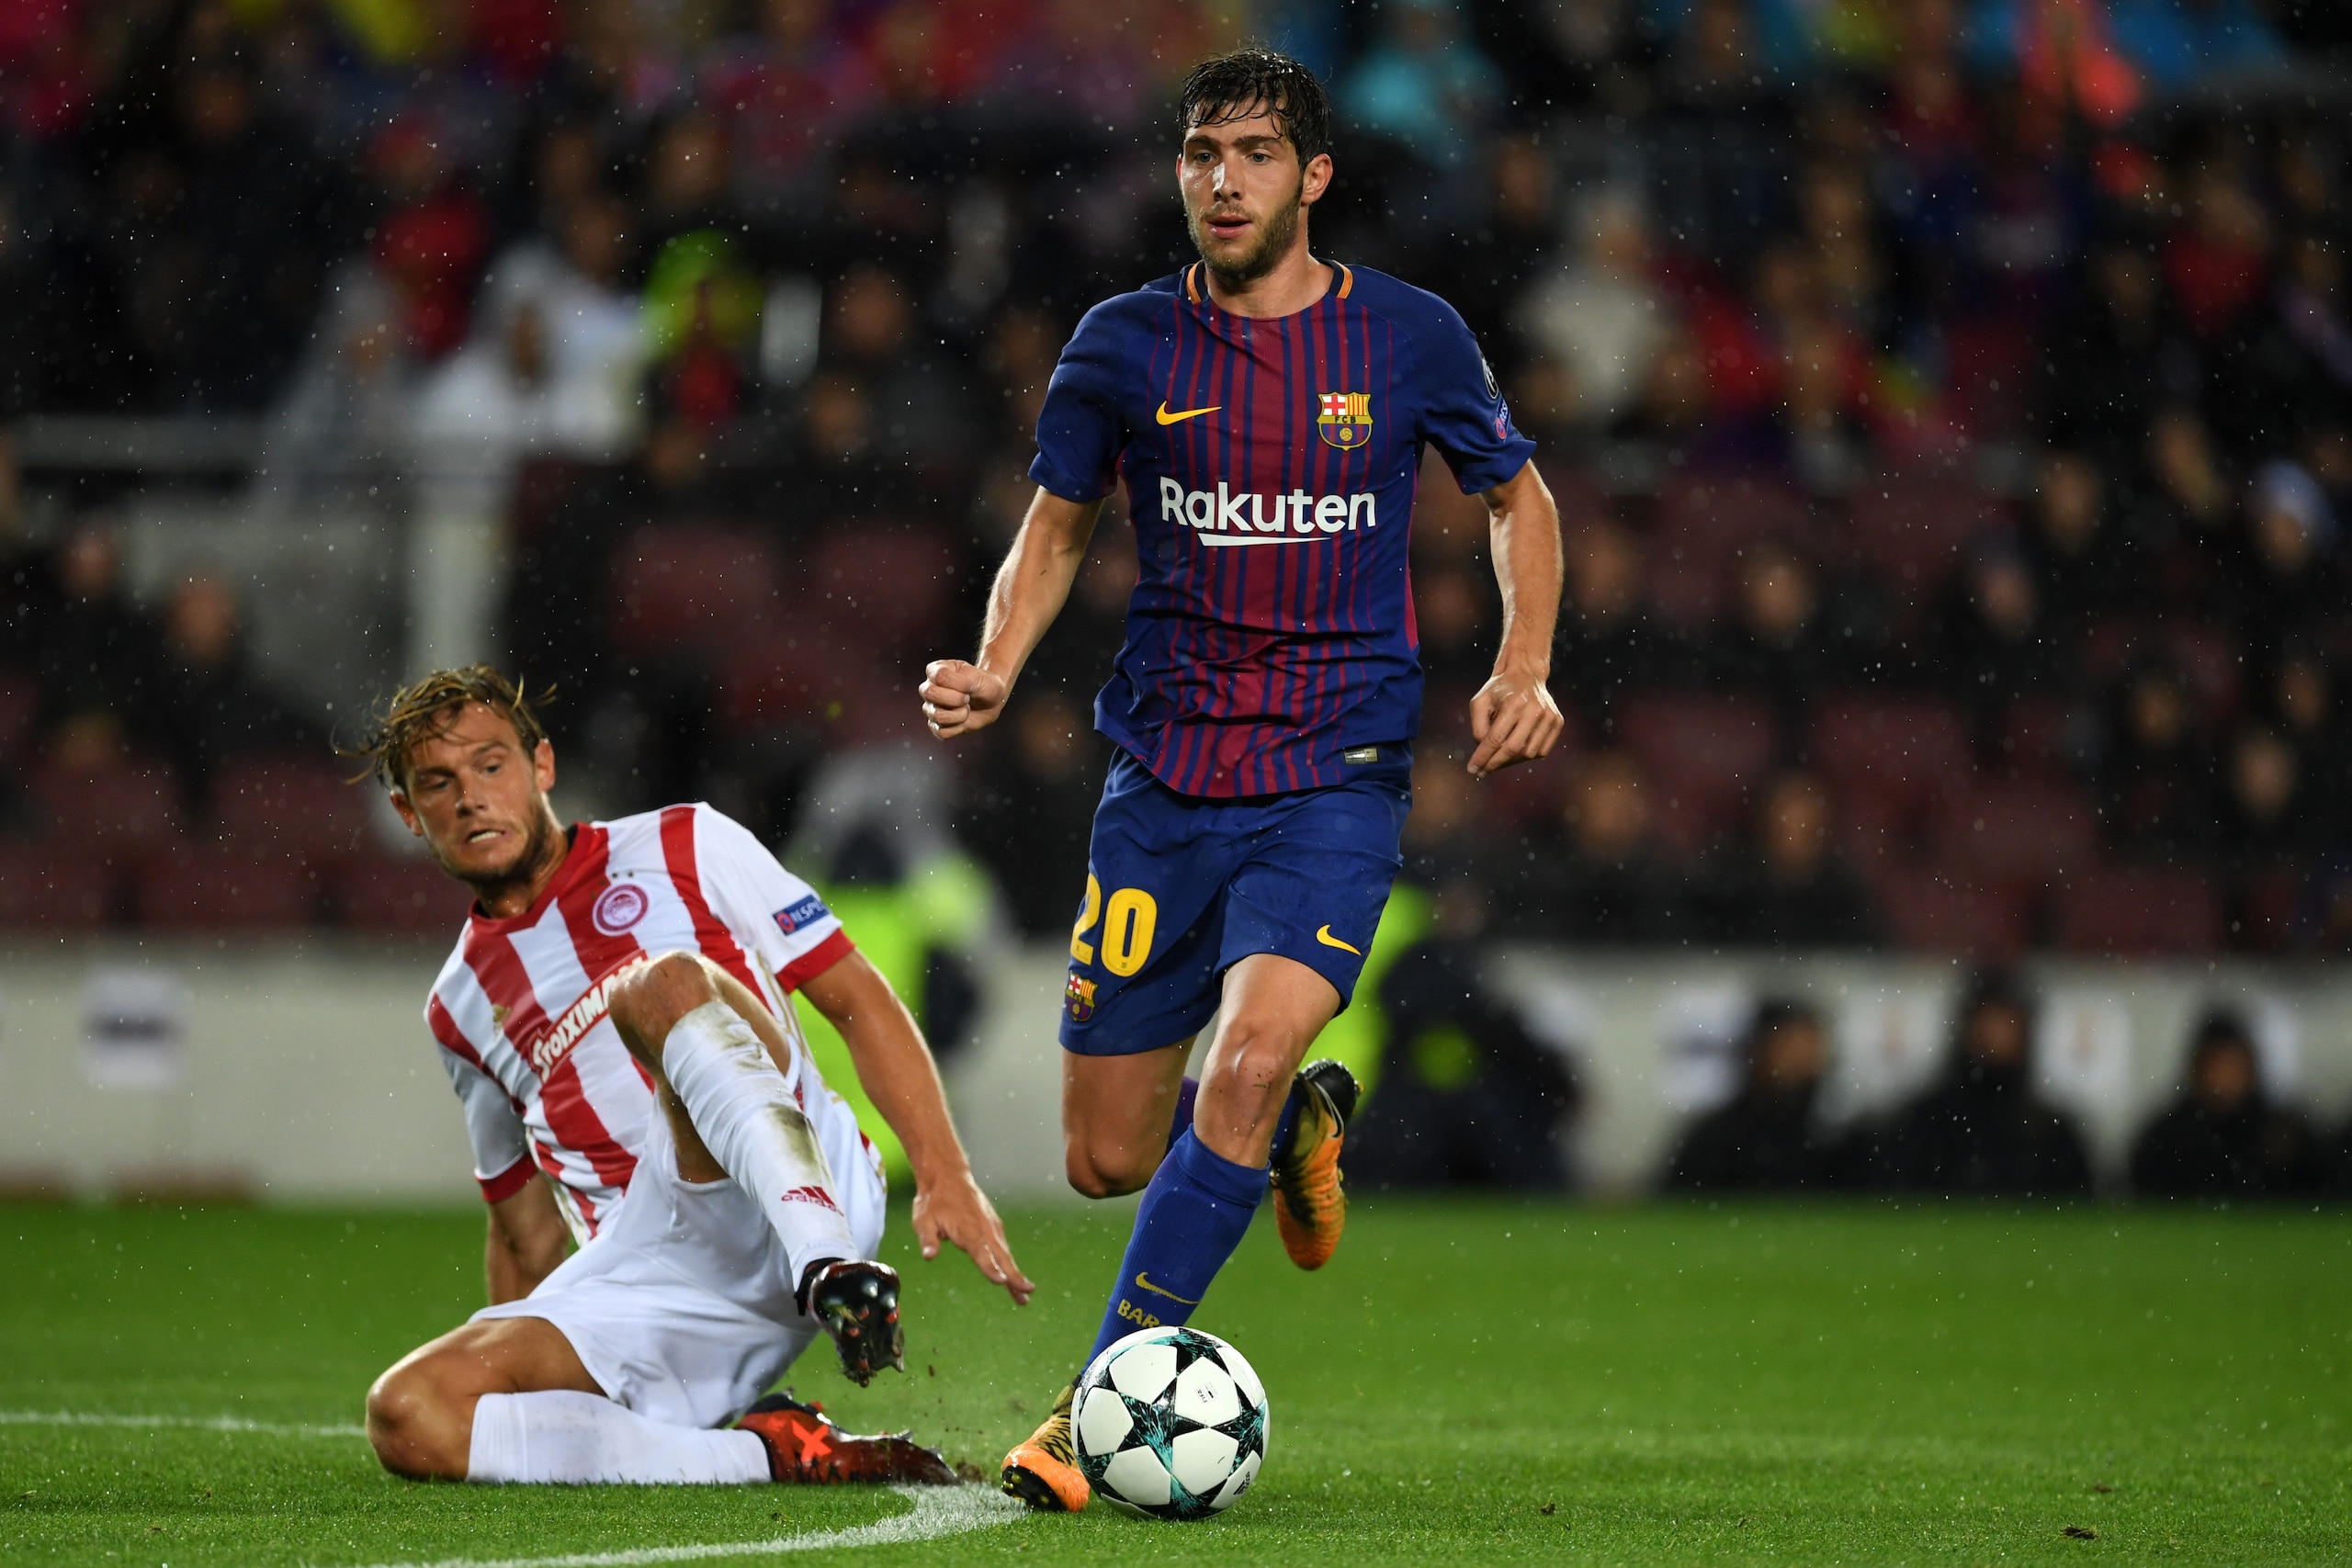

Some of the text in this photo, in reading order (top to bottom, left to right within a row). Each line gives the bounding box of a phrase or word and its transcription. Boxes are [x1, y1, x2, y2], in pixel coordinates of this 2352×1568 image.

[1159, 476, 1376, 534] Rakuten
[1070, 873, 1158, 977] 20
[1117, 1299, 1165, 1328] BAR
